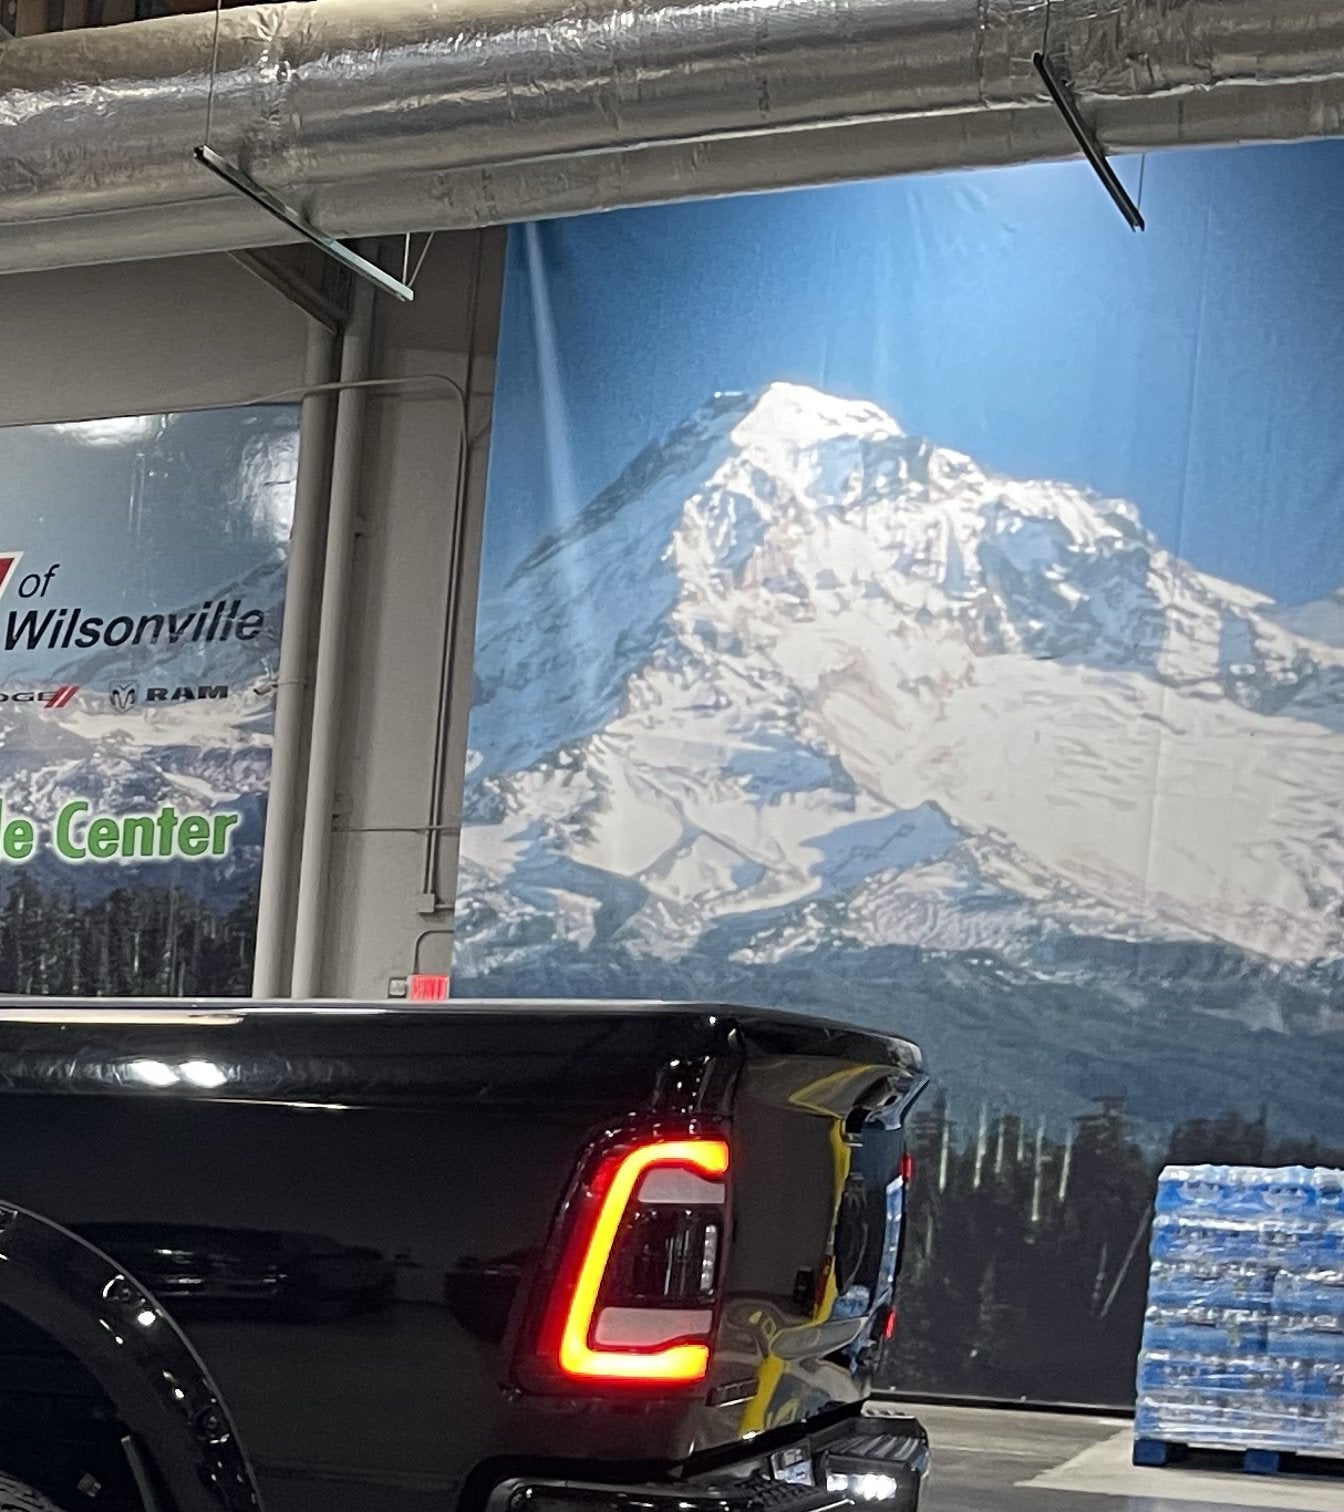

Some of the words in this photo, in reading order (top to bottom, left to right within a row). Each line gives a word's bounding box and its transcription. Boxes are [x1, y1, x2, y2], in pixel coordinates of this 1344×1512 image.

[18, 564, 60, 599] of
[4, 599, 265, 651] Wilsonville
[145, 685, 229, 702] RAM
[55, 800, 239, 860] Center
